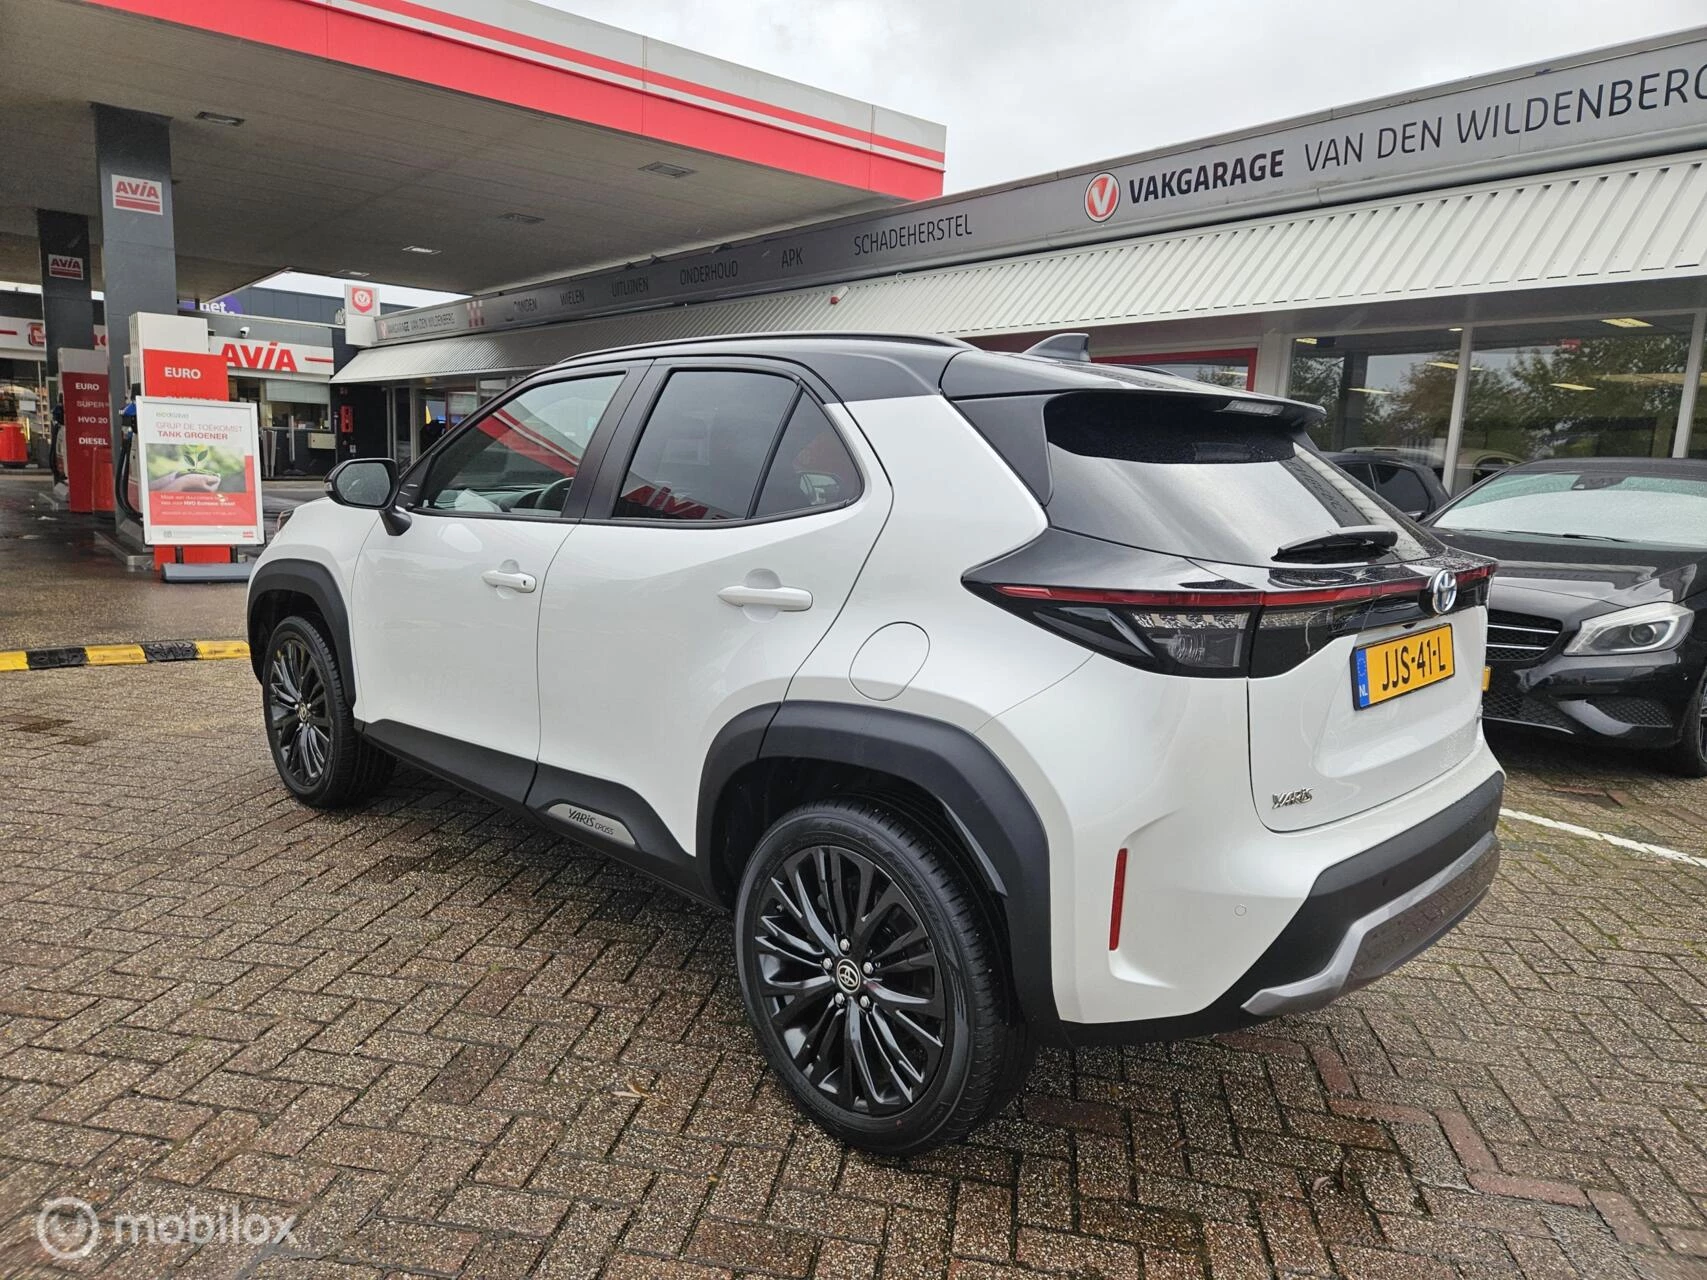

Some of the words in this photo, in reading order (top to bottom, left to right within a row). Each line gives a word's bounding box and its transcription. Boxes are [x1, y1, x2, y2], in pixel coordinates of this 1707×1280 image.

[1129, 149, 1284, 204] VAKGARAGE
[1305, 132, 1364, 171] VAN
[1377, 116, 1442, 159] DEN
[854, 213, 972, 256] SCHADEHERSTEL
[781, 248, 804, 269] APK
[680, 260, 738, 286] ONDERHOUD
[560, 288, 585, 306] WIELEN
[164, 366, 201, 380] EURO
[75, 382, 100, 391] EURO
[76, 401, 105, 409] SUPER
[78, 416, 97, 424] HVO
[78, 437, 108, 445] DIESEL
[157, 430, 182, 438] TANK
[184, 432, 228, 440] GROENER
[1382, 636, 1446, 691] JJS-41-L
[1359, 685, 1368, 697] NL
[595, 822, 614, 835] CROSS
